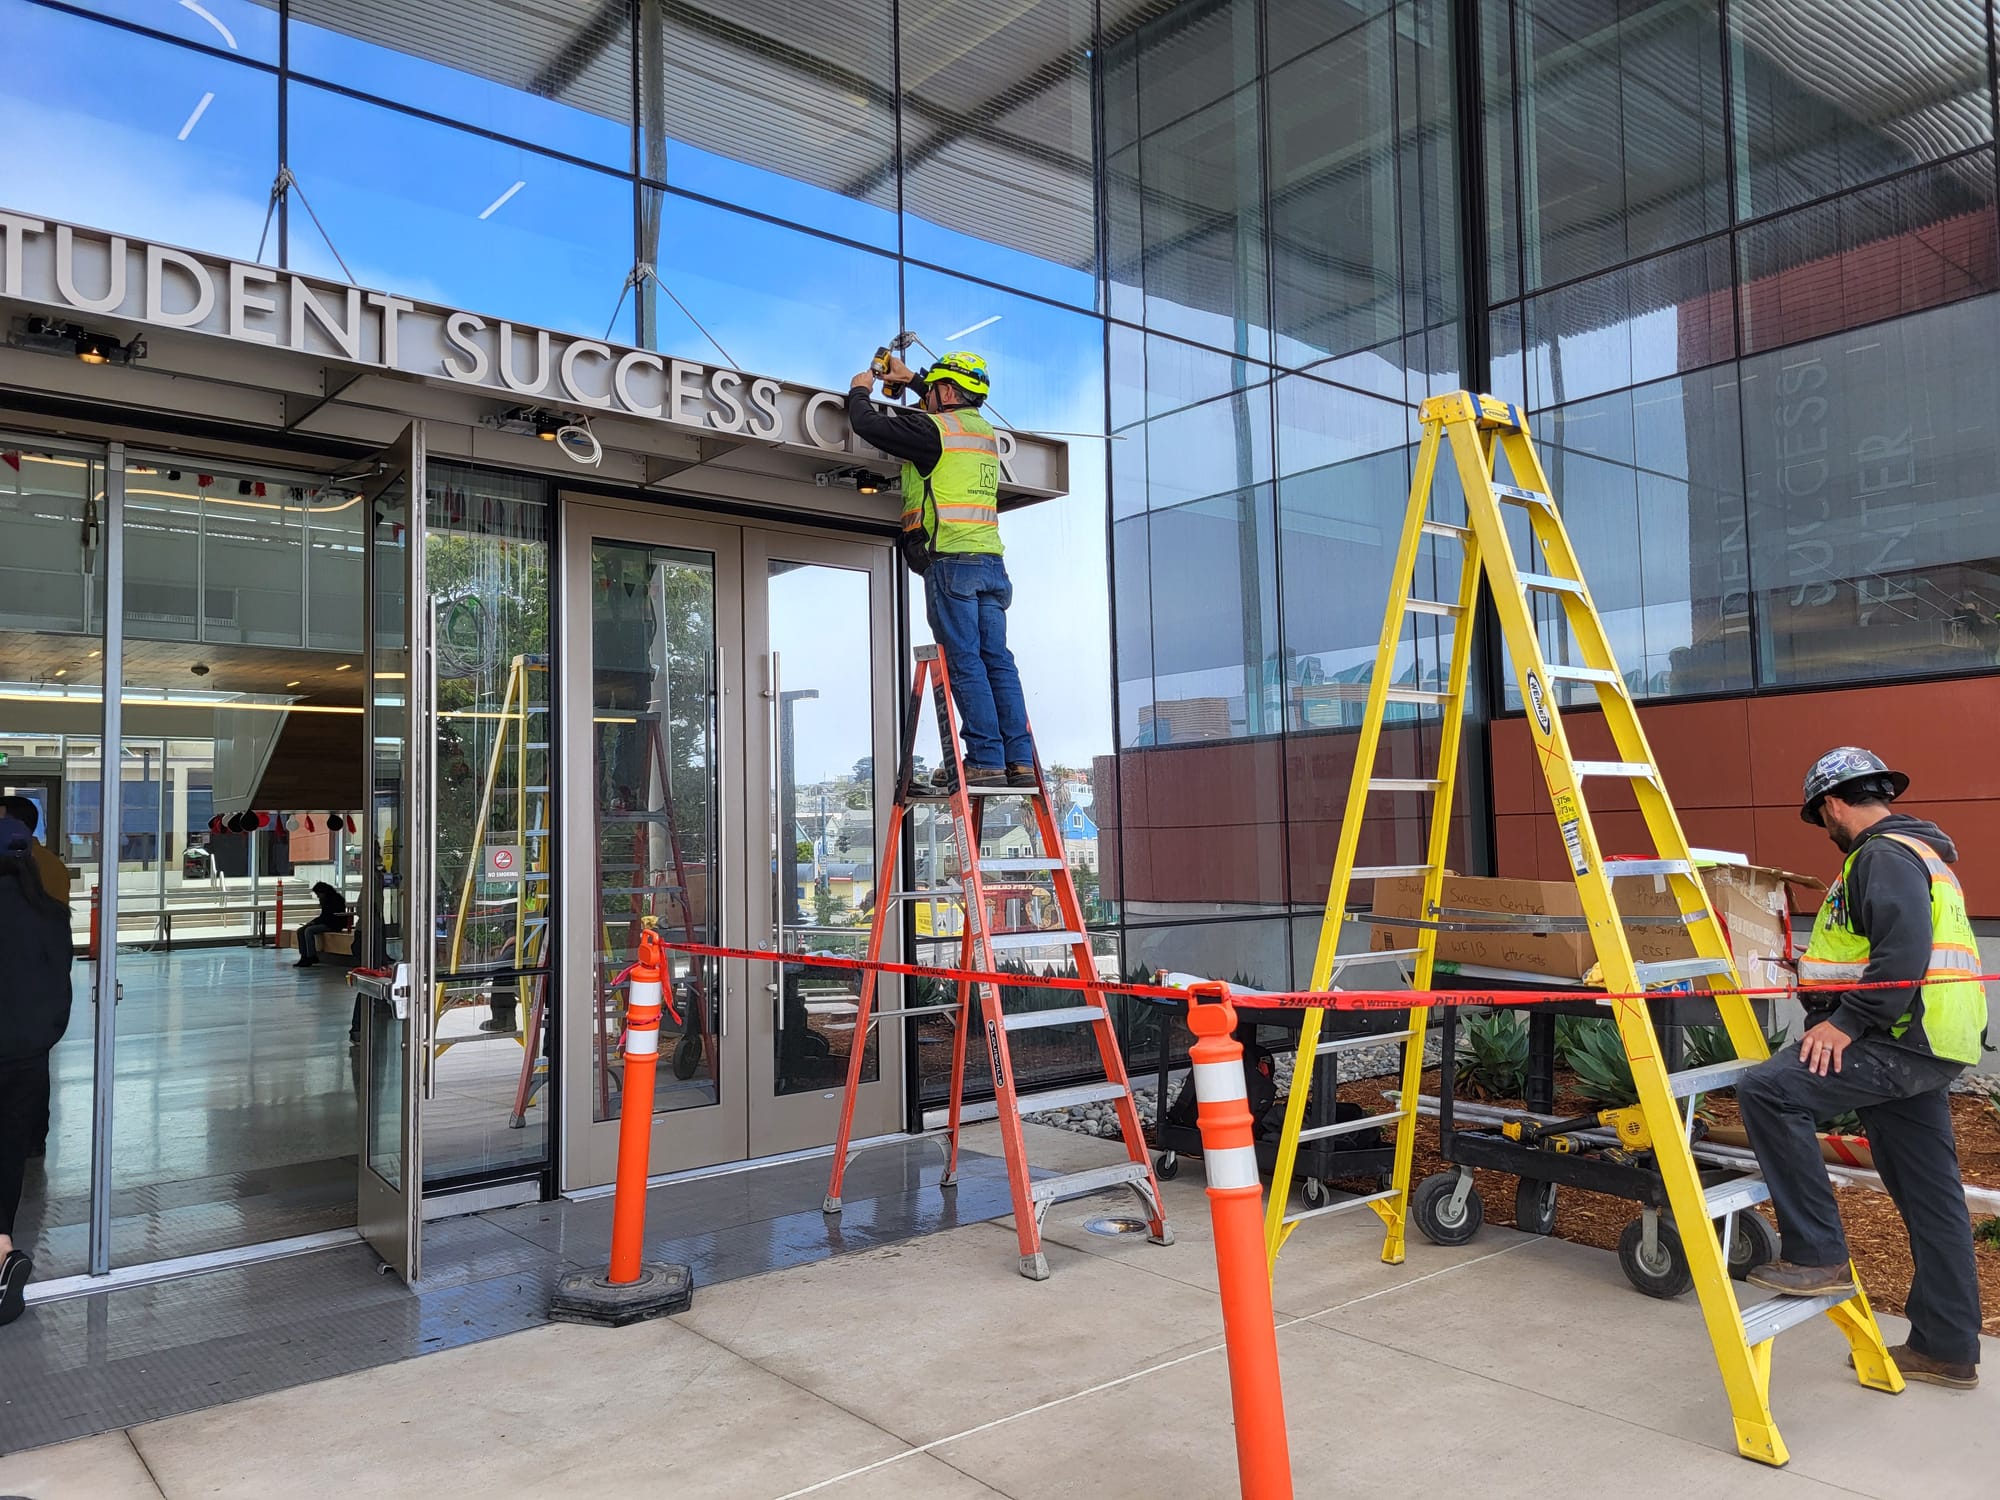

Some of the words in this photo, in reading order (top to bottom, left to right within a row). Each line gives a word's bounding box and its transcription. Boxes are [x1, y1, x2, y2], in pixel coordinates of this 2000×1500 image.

[441, 312, 784, 439] SUCCESS
[1450, 888, 1491, 907] Success
[990, 1031, 1003, 1085] LOUISVILLE
